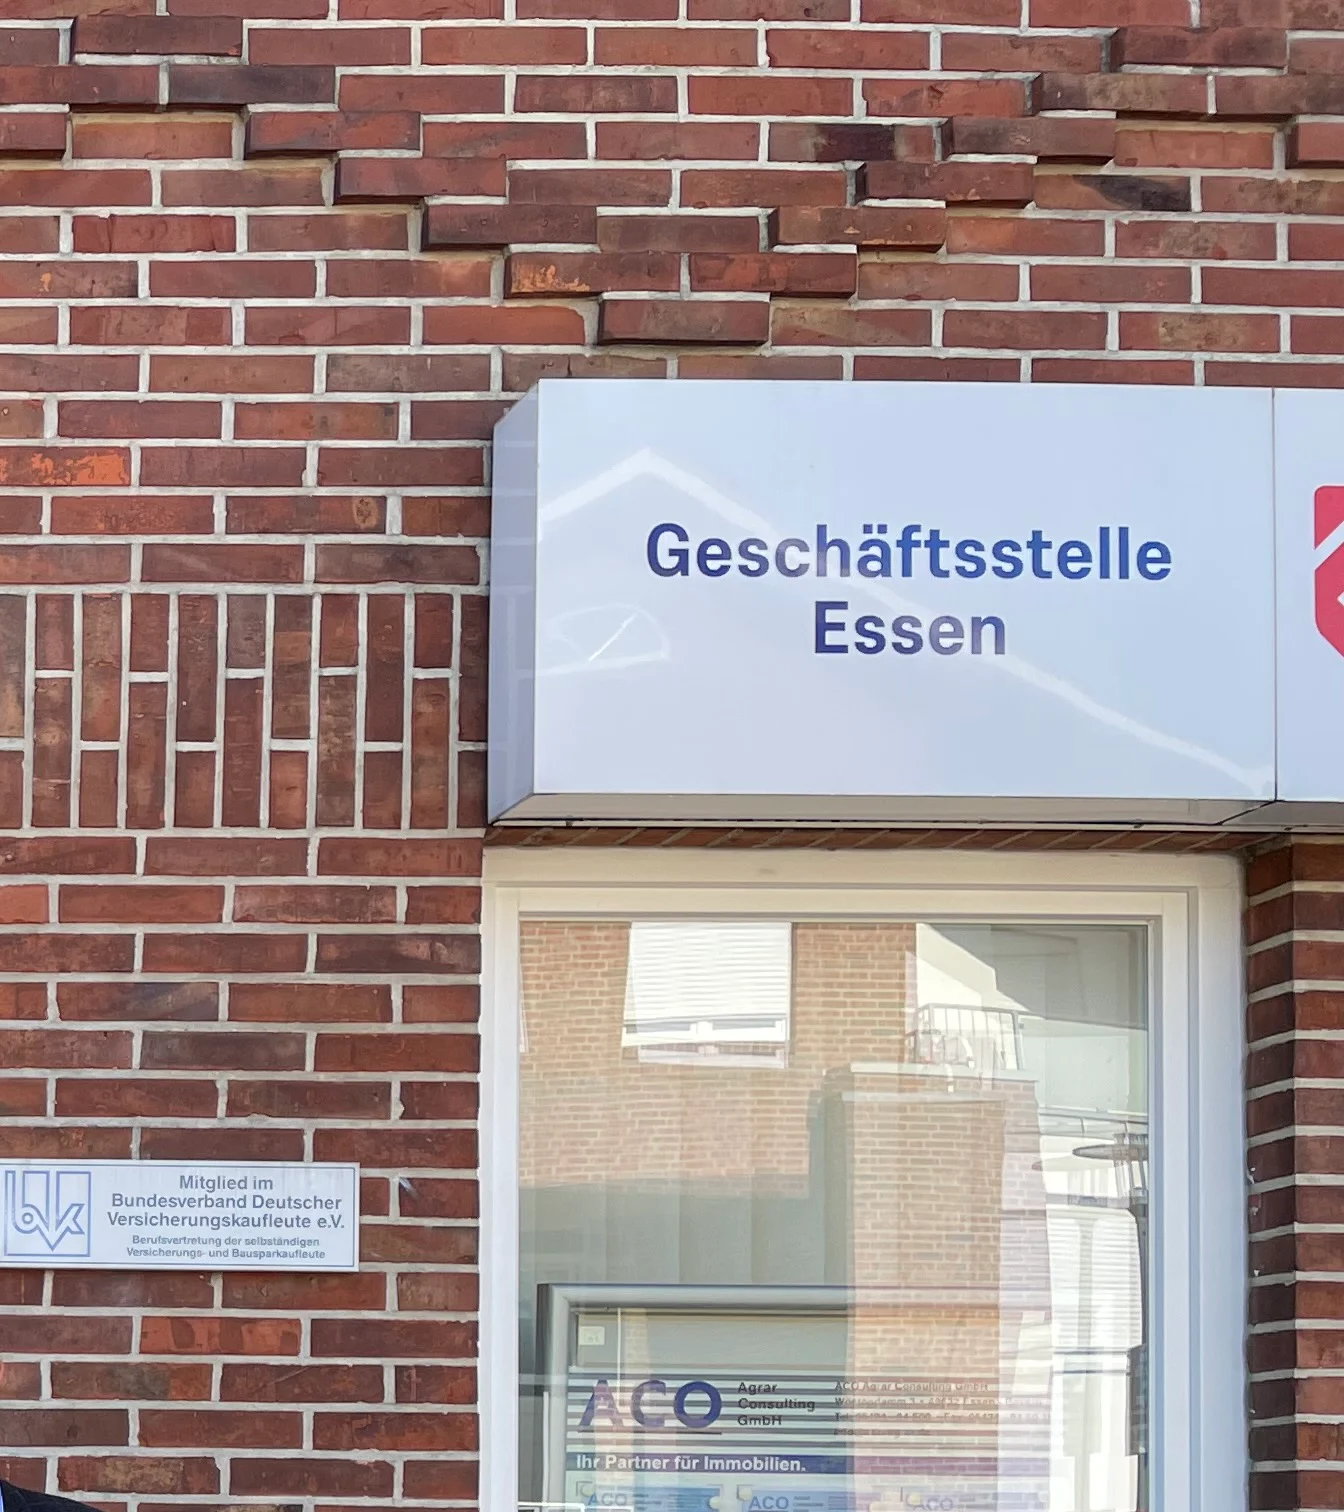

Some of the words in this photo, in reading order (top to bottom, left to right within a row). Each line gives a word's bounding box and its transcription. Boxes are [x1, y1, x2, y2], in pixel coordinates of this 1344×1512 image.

[646, 522, 1173, 582] Geschäftsstelle
[814, 601, 1007, 656] Essen
[179, 1175, 248, 1193] Mitglied
[253, 1176, 274, 1190] im
[112, 1193, 247, 1209] Bundesverband
[252, 1194, 343, 1210] Deutscher
[107, 1211, 312, 1231] Versicherungskaufleute
[317, 1214, 345, 1229] e.V.
[132, 1234, 222, 1248] Berufsvertretung
[224, 1236, 242, 1246] der
[244, 1237, 320, 1249] selbständigen
[126, 1247, 206, 1259] Versicherungs-
[208, 1249, 229, 1258] und
[232, 1248, 327, 1260] Bausparkaufleute
[737, 1382, 778, 1395] Agrar
[578, 1380, 723, 1428] ACO
[737, 1398, 816, 1412] Consulting
[737, 1414, 783, 1426] GmbH
[576, 1454, 600, 1469] Ihr
[605, 1456, 669, 1471] Partner
[674, 1456, 699, 1471] für
[704, 1457, 807, 1472] Immobilien.
[588, 1492, 628, 1506] ACO
[749, 1496, 790, 1510] ACO
